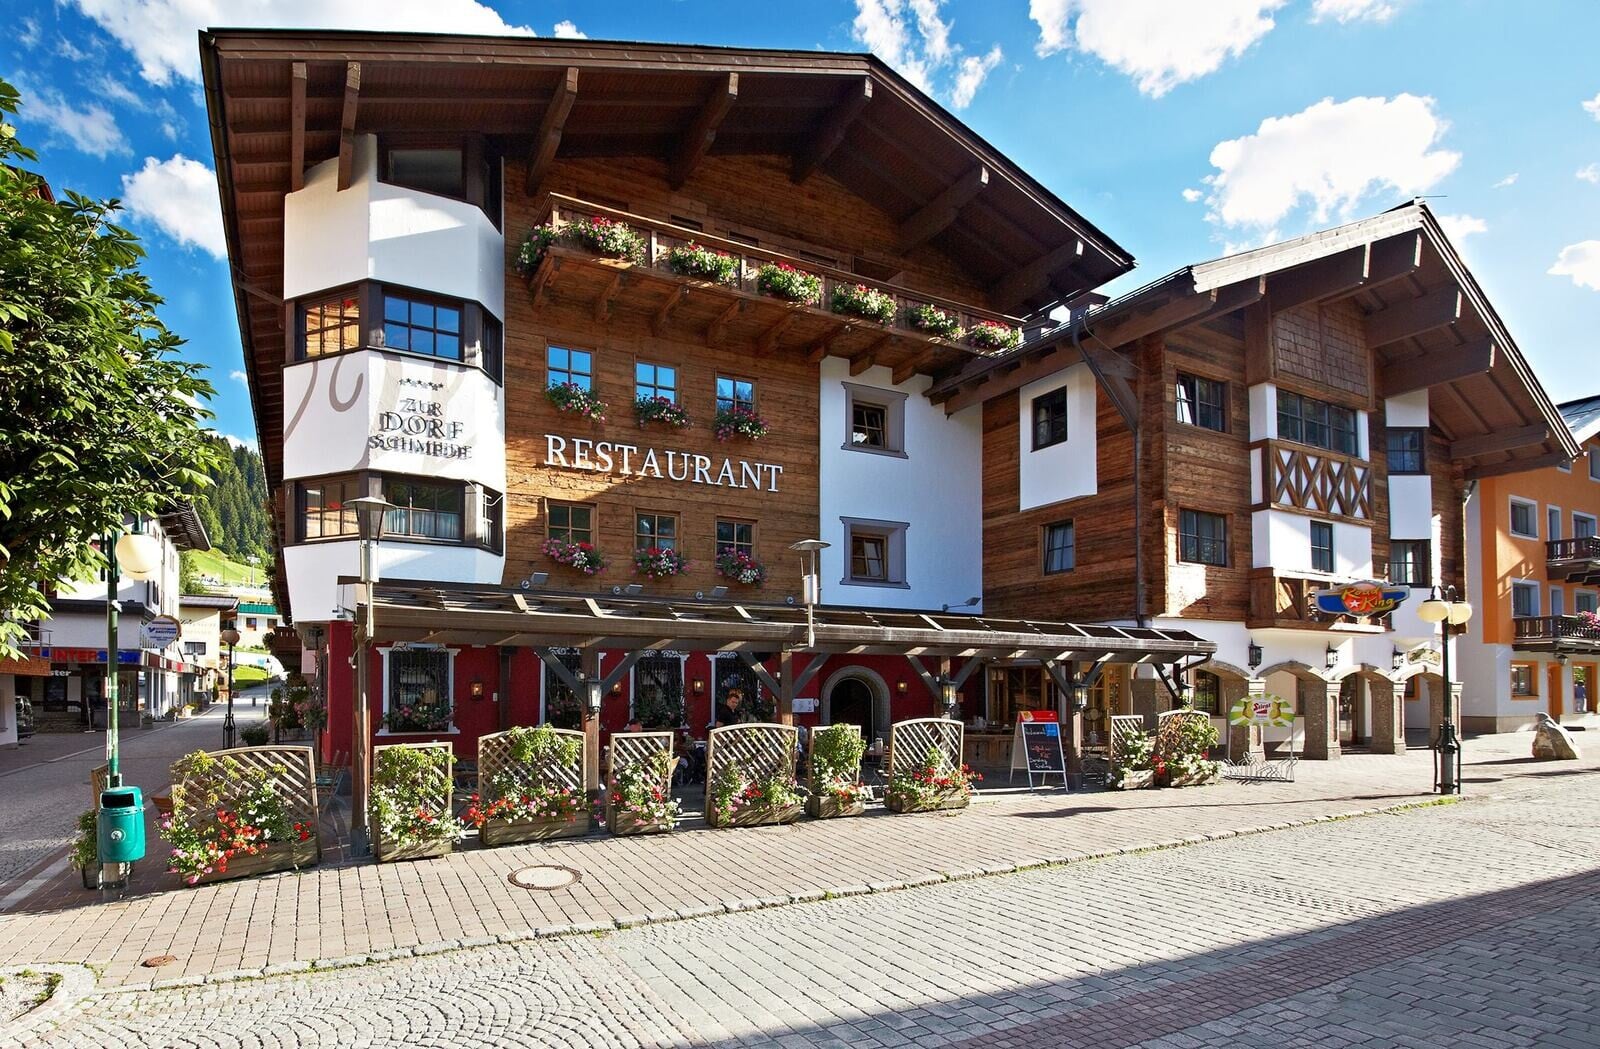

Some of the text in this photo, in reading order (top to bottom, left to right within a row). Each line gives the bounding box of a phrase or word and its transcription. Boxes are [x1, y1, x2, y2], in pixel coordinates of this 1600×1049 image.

[400, 398, 443, 417] ZUR
[379, 411, 464, 439] DORF
[369, 434, 472, 460] SCHMIEDE
[543, 434, 783, 493] RESTAURANT
[1341, 586, 1381, 600] Road
[1360, 598, 1395, 611] King
